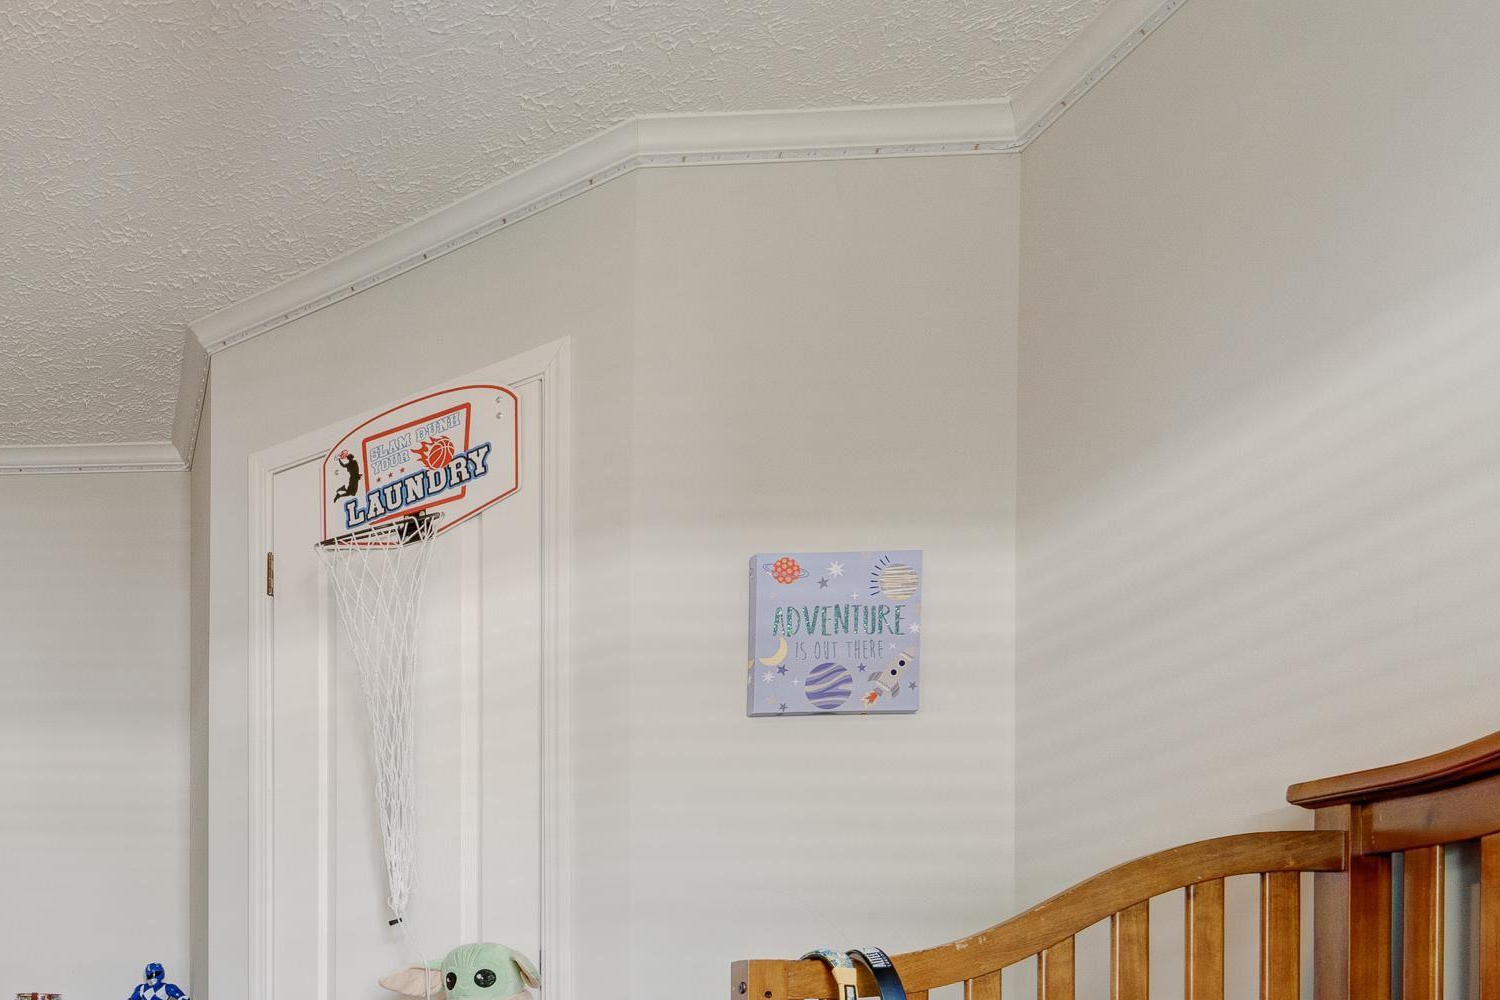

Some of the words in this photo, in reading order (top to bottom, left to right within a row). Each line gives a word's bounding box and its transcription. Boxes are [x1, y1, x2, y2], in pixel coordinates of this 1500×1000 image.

[370, 432, 411, 462] SLAM
[415, 412, 460, 442] DUNK
[371, 450, 411, 475] YOUR
[345, 441, 492, 529] LAUNDRY
[772, 604, 906, 637] ADVENTURE
[795, 642, 807, 660] IS
[814, 641, 838, 660] OUT
[845, 640, 884, 659] THERE
